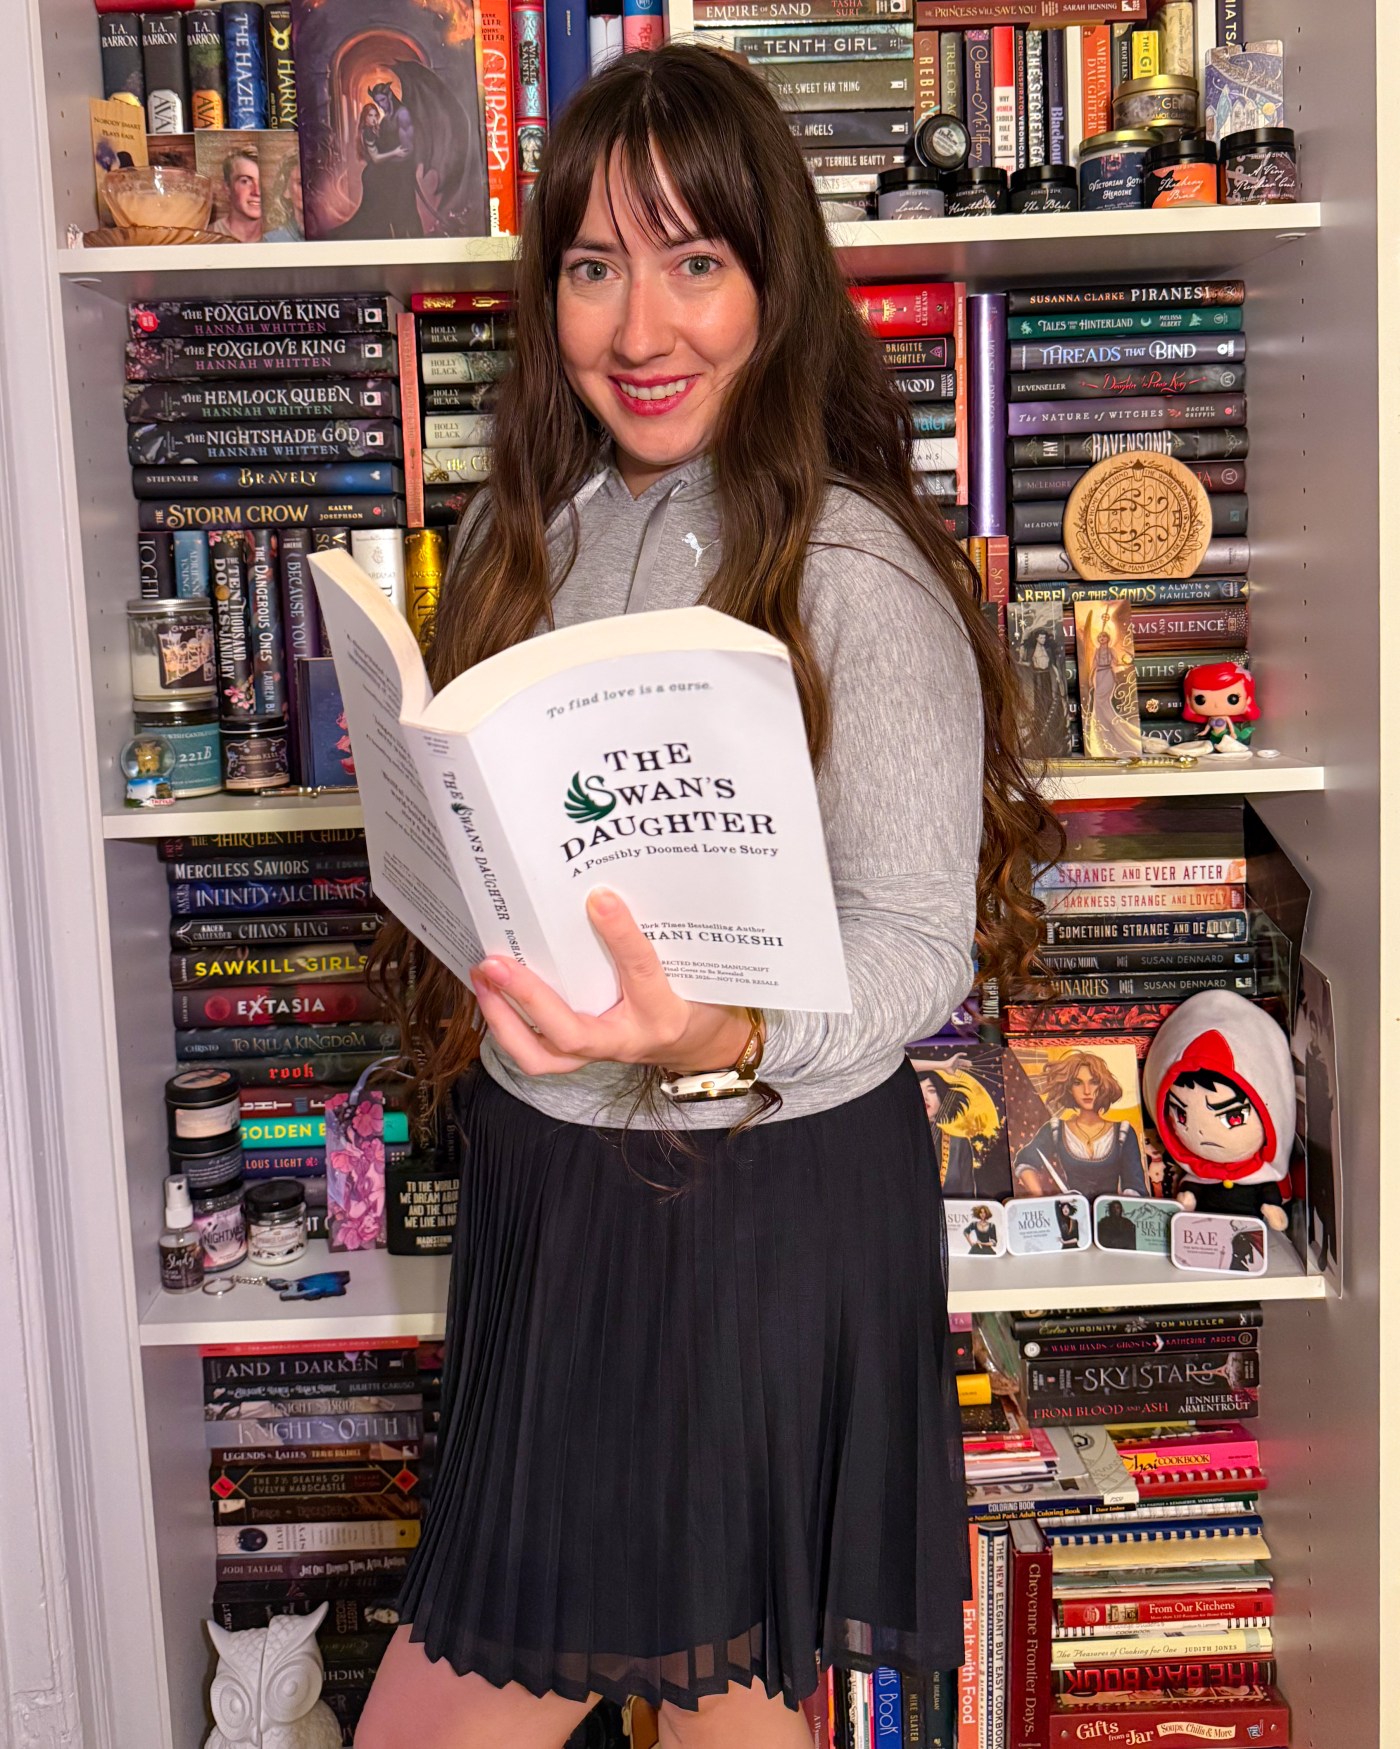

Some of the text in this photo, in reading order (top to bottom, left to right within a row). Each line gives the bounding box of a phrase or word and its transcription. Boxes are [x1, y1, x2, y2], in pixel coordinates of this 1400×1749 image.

[706, 3, 811, 19] EMPIRE SAND
[836, 8, 859, 16] SURI
[934, 5, 1037, 18] PRINCESS SAVE YOU
[1062, 3, 1117, 12] SARAH HENNING
[102, 35, 139, 48] BARRON
[142, 33, 177, 46] BARRON
[187, 33, 220, 46] BARRON
[763, 37, 877, 54] TENTH GIRL
[235, 13, 253, 113] THE HAZEL
[970, 45, 988, 79] Clara
[945, 44, 956, 96] TREE OF
[277, 59, 298, 127] HARRY
[795, 81, 860, 94] SWEET FAR THING
[1087, 57, 1097, 130] DAUGHTER
[995, 105, 1013, 113] WOMEN
[1030, 83, 1042, 140] SECRET
[804, 125, 834, 135] ANGELS
[824, 155, 885, 166] TERRIBLE BEAUTY
[1089, 179, 1125, 192] VICTORIAN
[1103, 189, 1132, 200] HEROINE
[1029, 286, 1210, 304] SUSANNA CLARKE PIRANESI
[204, 302, 340, 323] FOXGLOVE KING
[194, 322, 327, 335] HANNAH WHITTEN
[430, 326, 456, 334] HOLLY
[1038, 318, 1133, 332] TALES HINTERLAND
[431, 334, 458, 342] BLACK
[206, 339, 346, 358] FOXGLOVE KING
[885, 342, 922, 352] BRIGITTE
[1039, 340, 1197, 365] THREADS THAT BIND
[195, 357, 332, 371] HANNAH WHITTEN
[431, 368, 458, 376] BLACK
[1017, 383, 1066, 392] LEVENSELLER
[204, 386, 353, 407] HEMLOCK QUEEN
[202, 405, 334, 417] HANNAH WHITTEN
[1018, 410, 1163, 423] The NATURE of WITCHES
[206, 427, 360, 445] NIGHTSHADE GOD
[207, 446, 340, 457] HANNAH WHITTEN
[238, 468, 319, 488] BRAVELY
[166, 505, 309, 529] STORM CROW
[287, 561, 306, 618] BECAUSE
[1087, 586, 1156, 601] THE SANDS
[1159, 591, 1211, 600] HAMILTON
[228, 565, 246, 661] TEN THOUSAND
[255, 565, 274, 662] DANGEROUS ONES
[1167, 620, 1225, 634] SILENCE
[219, 630, 235, 679] JANUARY
[547, 683, 665, 719] To find love is a
[604, 743, 693, 773] THE
[582, 773, 736, 821] SWAN'S
[560, 810, 776, 863] DAUGHTER
[572, 843, 778, 877] A Possibly Doomed Love Story
[175, 859, 310, 880] MERCILESS SAVIORS
[1059, 864, 1223, 884] STRANGE AND EVER AFTER
[474, 856, 510, 921] DAUGHTER
[196, 888, 271, 907] INFINITY
[1063, 891, 1229, 908] DARKNESS STRANGE LOVELY
[661, 921, 766, 933] Times Bestselling Author
[1057, 923, 1170, 940] SOMETHING STRANGE
[699, 932, 784, 947] CHOKSHI
[194, 955, 368, 977] SAWKILL GIRLS
[1140, 954, 1224, 965] SUSAN DENNARD
[721, 963, 770, 972] MANUSCRIPT
[1143, 978, 1227, 990] SUSAN DENNARD
[236, 995, 325, 1021] EXTASIA
[274, 1158, 302, 1169] LIGHT
[1021, 1209, 1044, 1221] THE
[1018, 1218, 1051, 1229] MOON
[1182, 1229, 1218, 1246] BAE
[1155, 1318, 1225, 1328] TOM MUELLER
[226, 1358, 378, 1378] AND DARKEN
[1075, 1405, 1124, 1417] BLOOD
[1178, 1401, 1250, 1414] ARMENTROUT
[1157, 1454, 1210, 1466] COOKBOOK
[988, 1501, 1035, 1512] COLORING BOOK
[1149, 1600, 1235, 1614] From Our Kitchens
[1027, 1563, 1040, 1684] Cheyenne Frontier
[1215, 1644, 1237, 1652] JONES
[961, 1650, 976, 1725] with Food
[1076, 1721, 1119, 1740] Gifts
